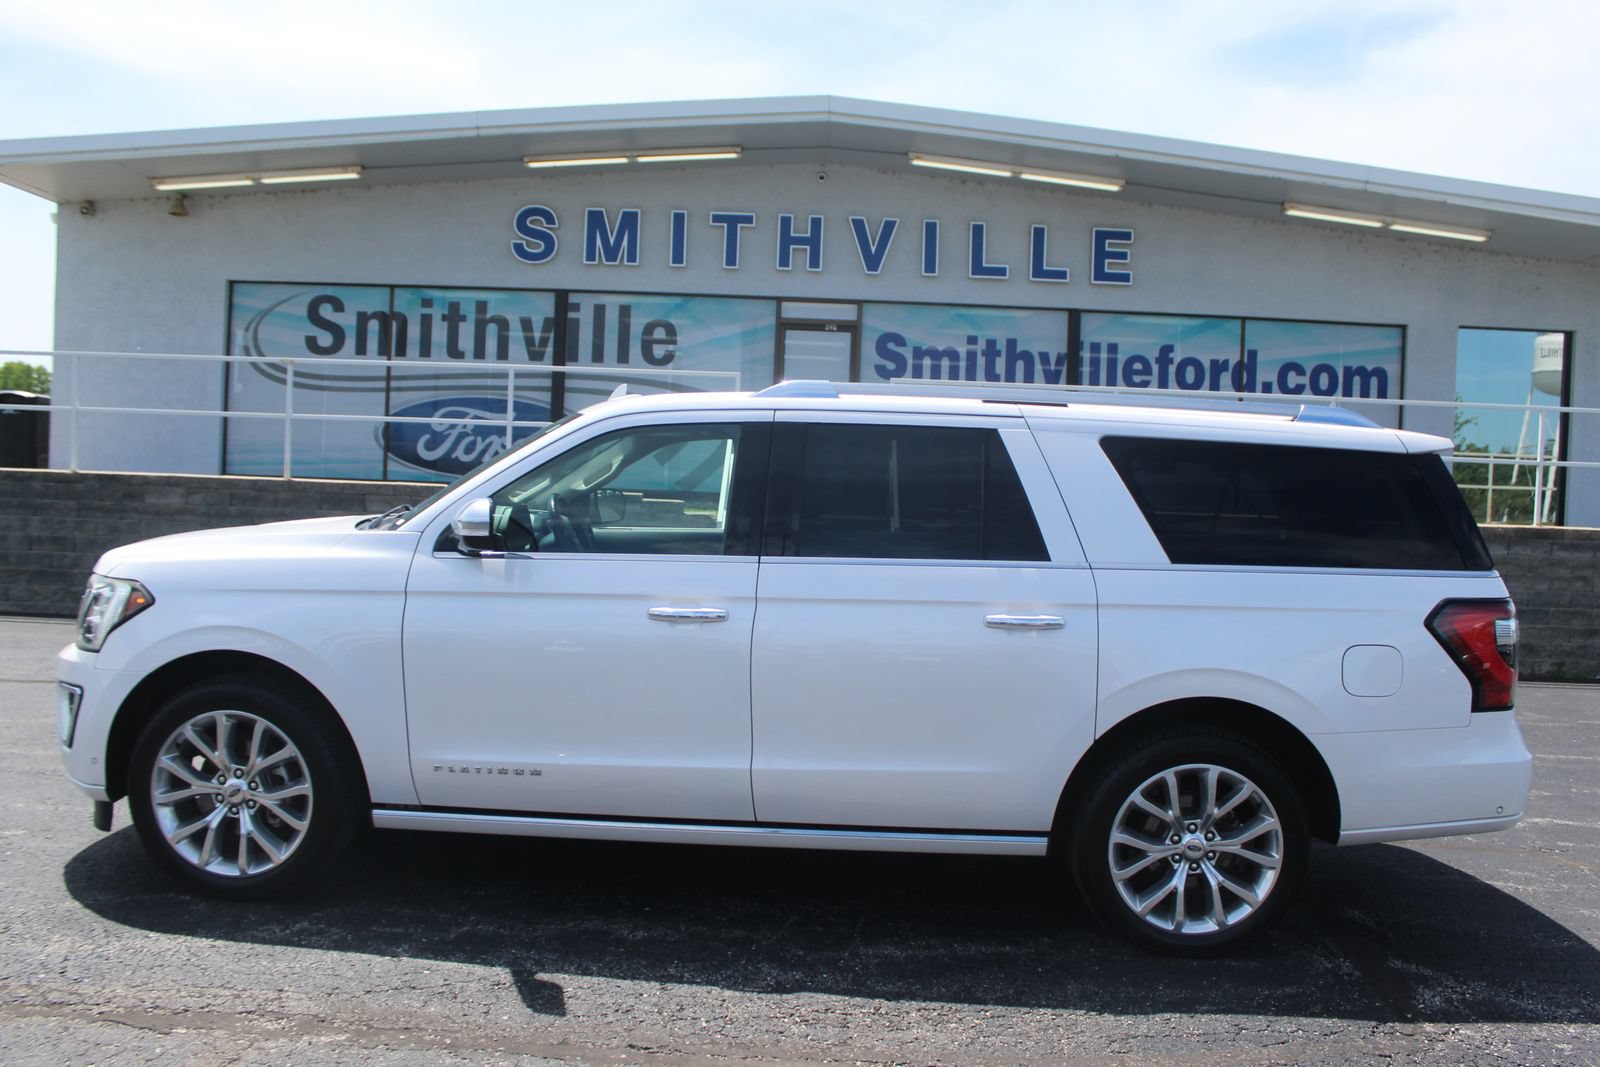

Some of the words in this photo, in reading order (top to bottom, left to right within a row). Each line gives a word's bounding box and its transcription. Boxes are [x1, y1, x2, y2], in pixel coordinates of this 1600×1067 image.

[510, 205, 1134, 284] SMITHVILLE
[304, 294, 679, 367] Smithville
[416, 406, 530, 462] For
